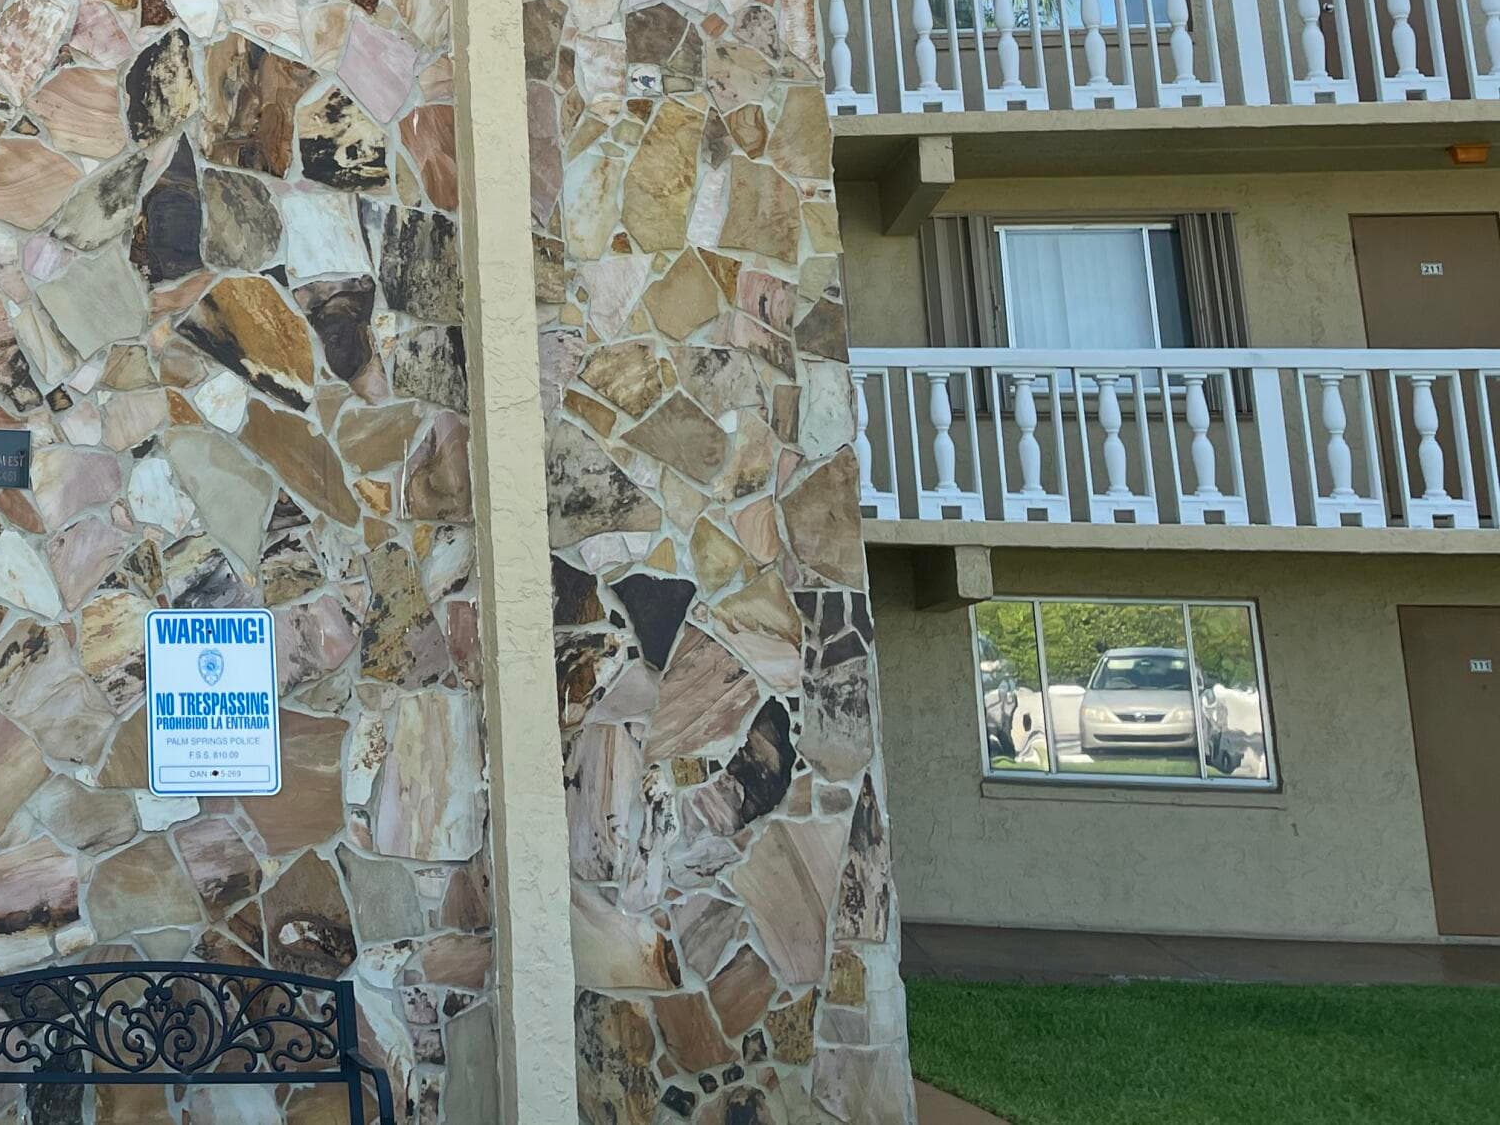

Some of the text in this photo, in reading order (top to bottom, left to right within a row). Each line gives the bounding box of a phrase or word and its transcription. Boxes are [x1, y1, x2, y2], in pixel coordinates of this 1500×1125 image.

[155, 618, 265, 645] WARNING!
[156, 692, 270, 716] NO TRESPASSING
[156, 716, 270, 730] PROHIBIDO LA ENTRADA
[166, 737, 260, 745] PALM SPRINGS POLICE
